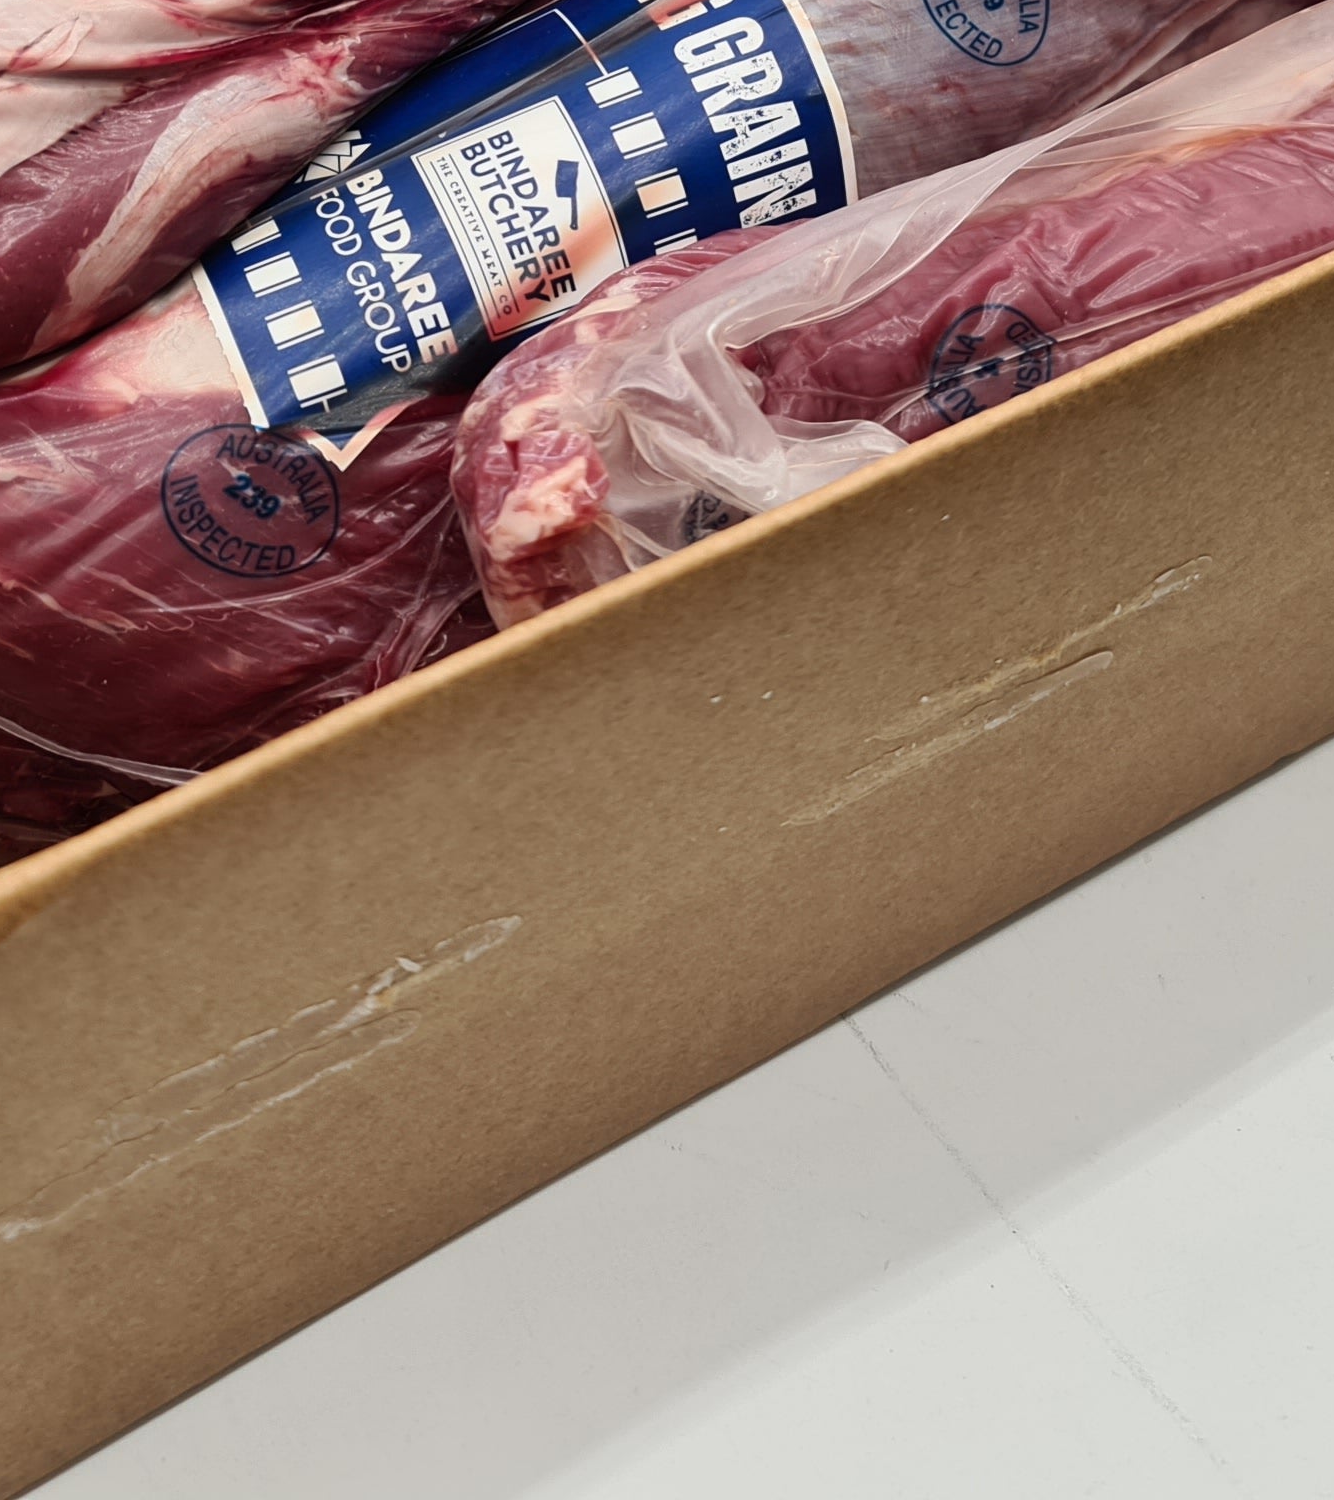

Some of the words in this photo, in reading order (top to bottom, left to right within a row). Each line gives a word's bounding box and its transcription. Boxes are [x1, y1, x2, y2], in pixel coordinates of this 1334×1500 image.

[673, 16, 817, 229] GRAIN
[310, 186, 363, 256] FOOD
[346, 260, 412, 373] GROUP
[345, 168, 459, 364] BINDAREE
[437, 156, 450, 178] THE
[450, 181, 485, 242] CREATIVE
[481, 249, 503, 287] MEAT
[499, 294, 513, 315] CO
[460, 141, 552, 303] BUTCHERY
[488, 130, 577, 298] BINDAREE
[170, 474, 295, 571] INSPECTED
[216, 433, 329, 525] AUSTRALIA
